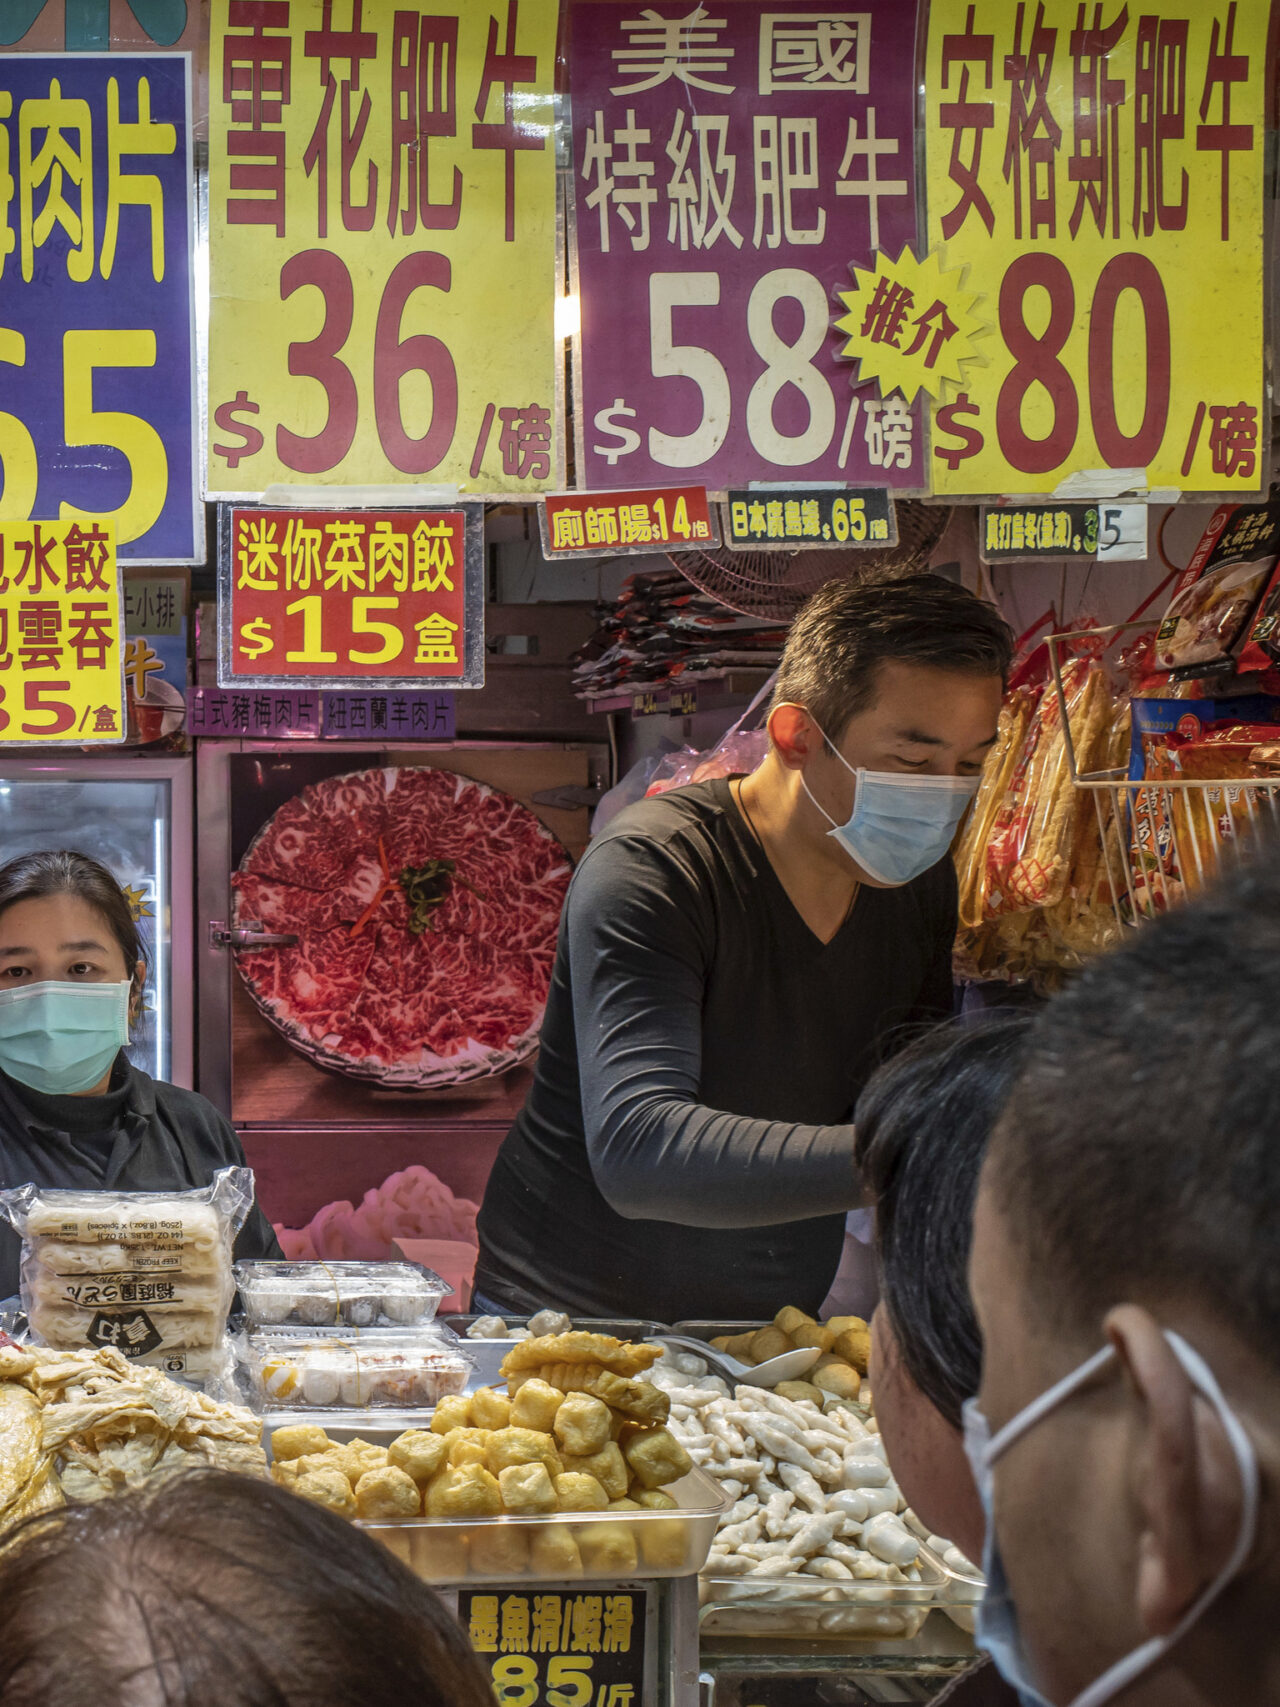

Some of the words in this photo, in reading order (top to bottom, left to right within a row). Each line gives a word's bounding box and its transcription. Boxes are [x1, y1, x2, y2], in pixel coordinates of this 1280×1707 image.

[610, 9, 872, 97] 美國
[940, 2, 1254, 242] 安格斯肥牛
[582, 107, 908, 253] 特級肥牛
[860, 276, 960, 369] 推介
[238, 517, 454, 592] 迷你菜肉餃
[328, 697, 450, 730] 紐西蘭羊肉片
